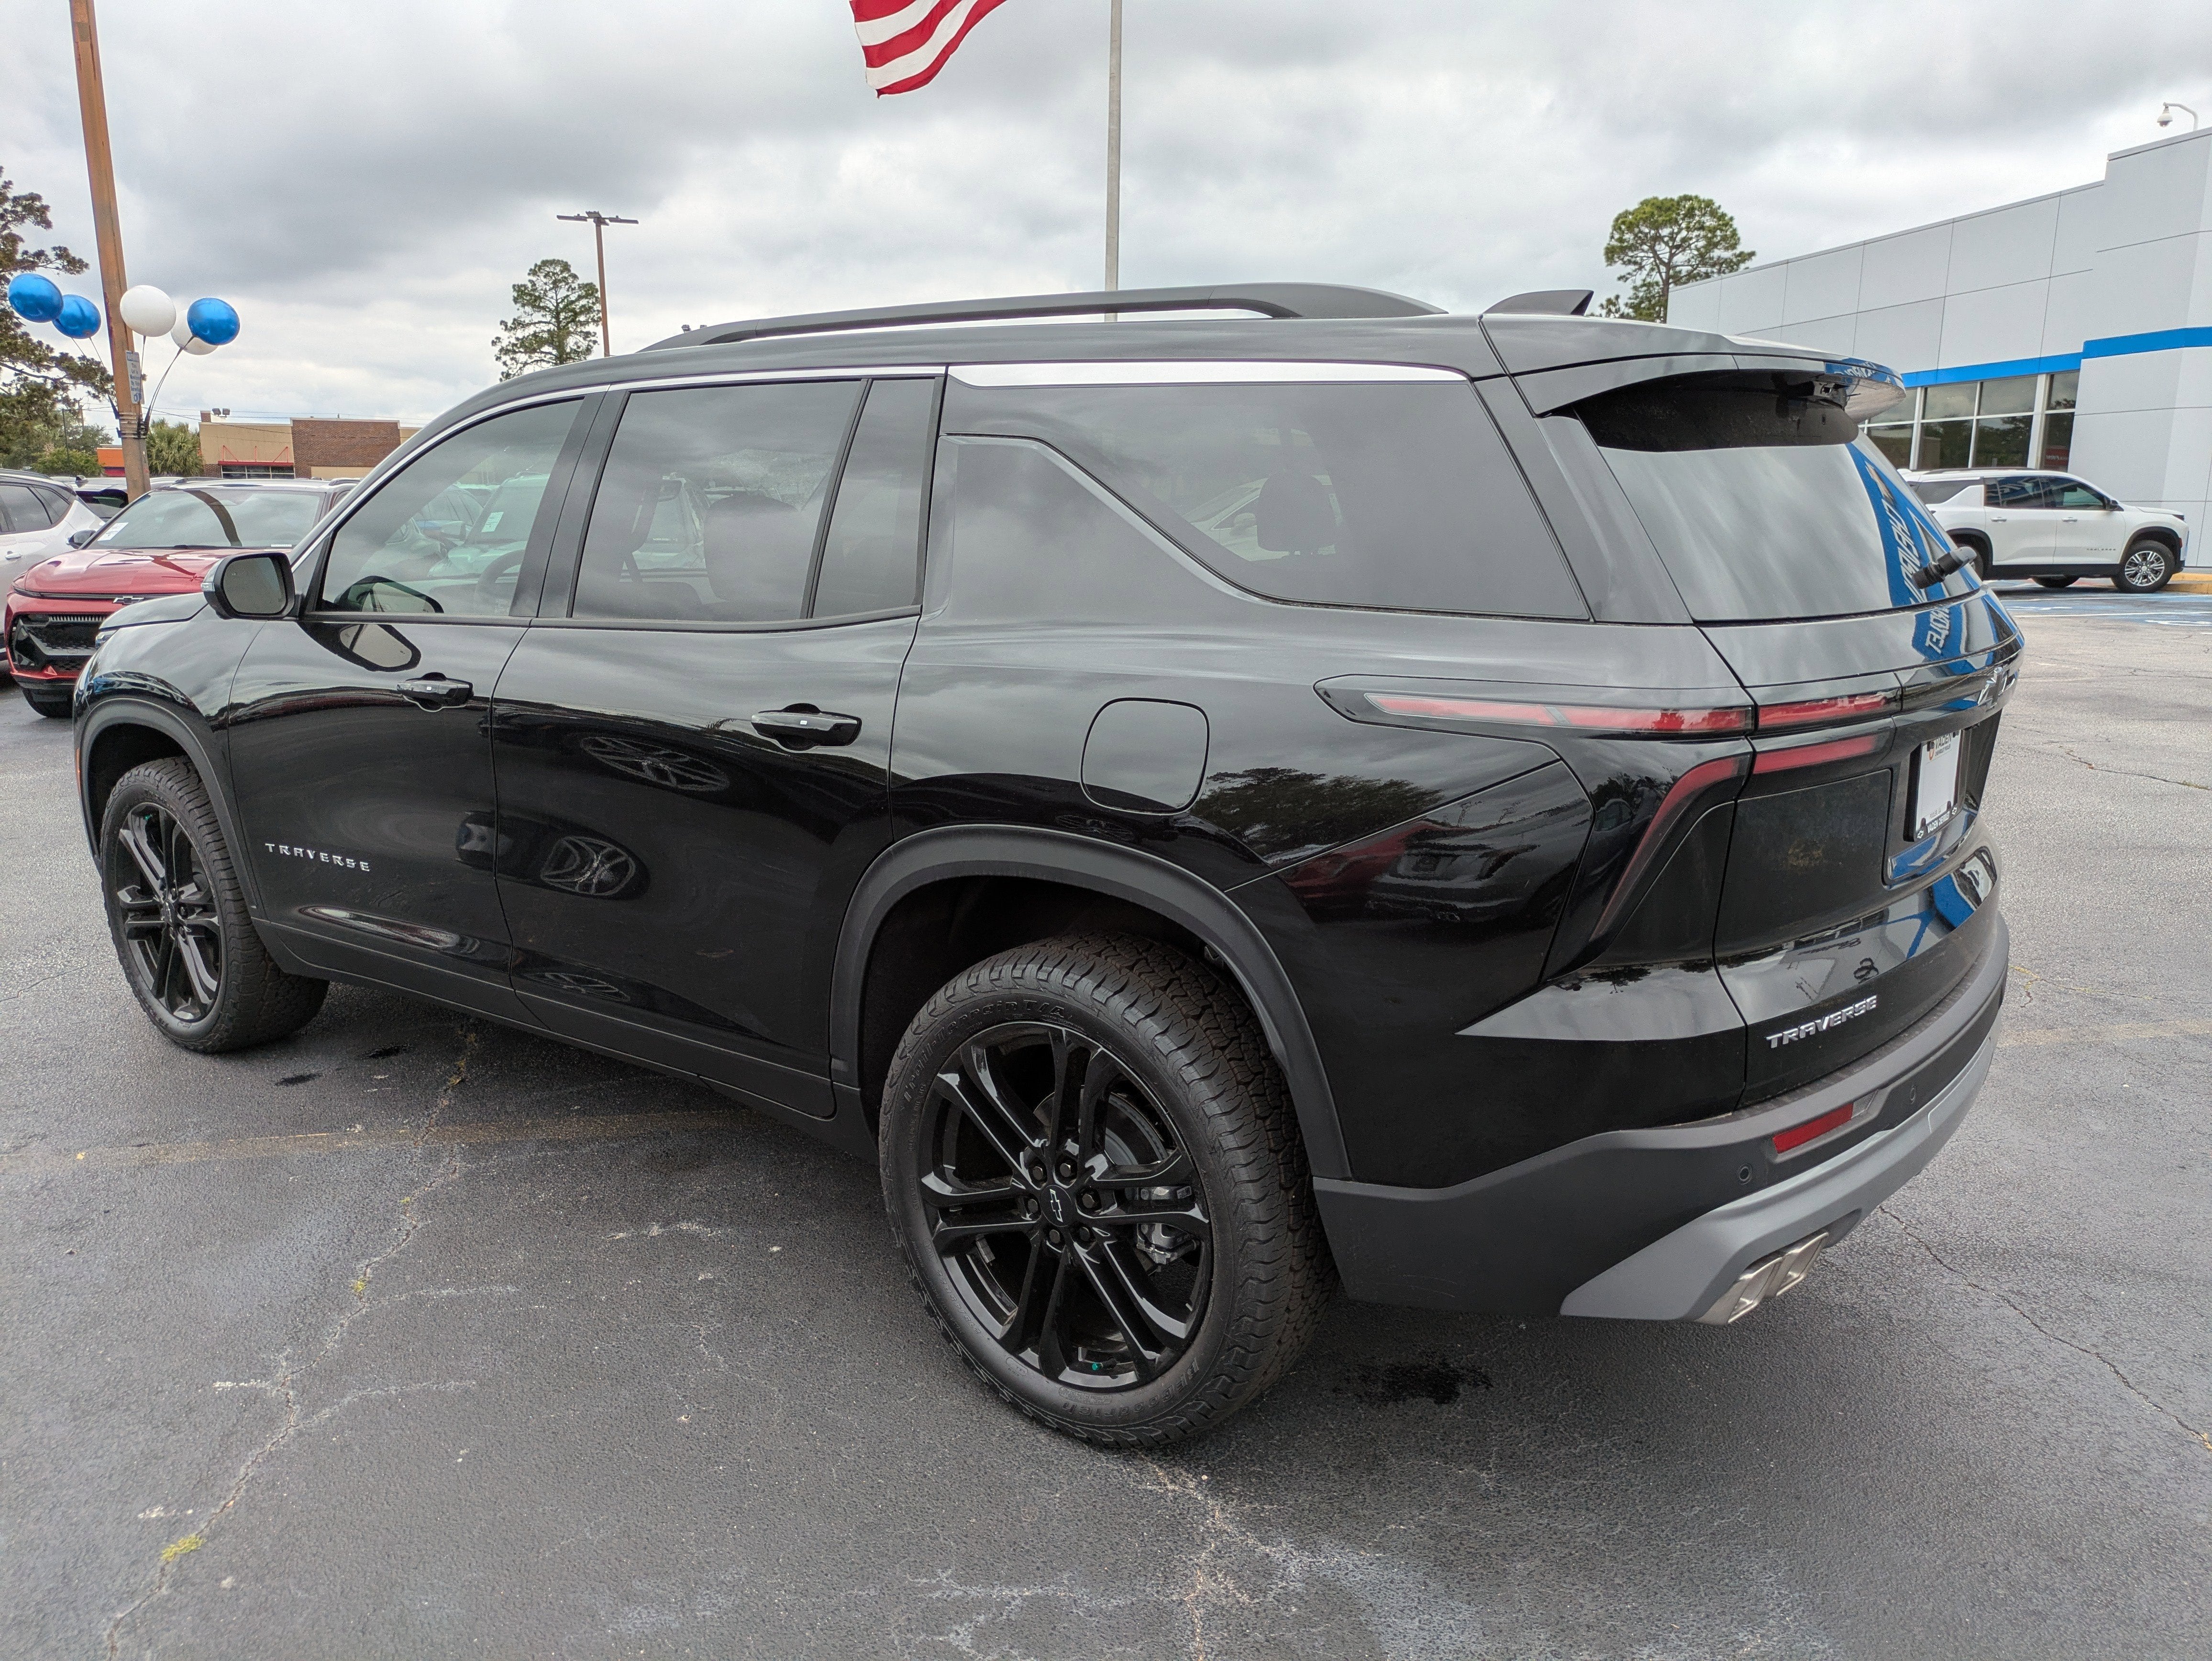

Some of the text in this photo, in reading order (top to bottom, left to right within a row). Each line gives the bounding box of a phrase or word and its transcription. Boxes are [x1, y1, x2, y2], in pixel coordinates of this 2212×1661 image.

[265, 843, 370, 872] TRAVERSE
[1023, 999, 1065, 1018] T/A
[1766, 995, 1878, 1048] TRAVERSE
